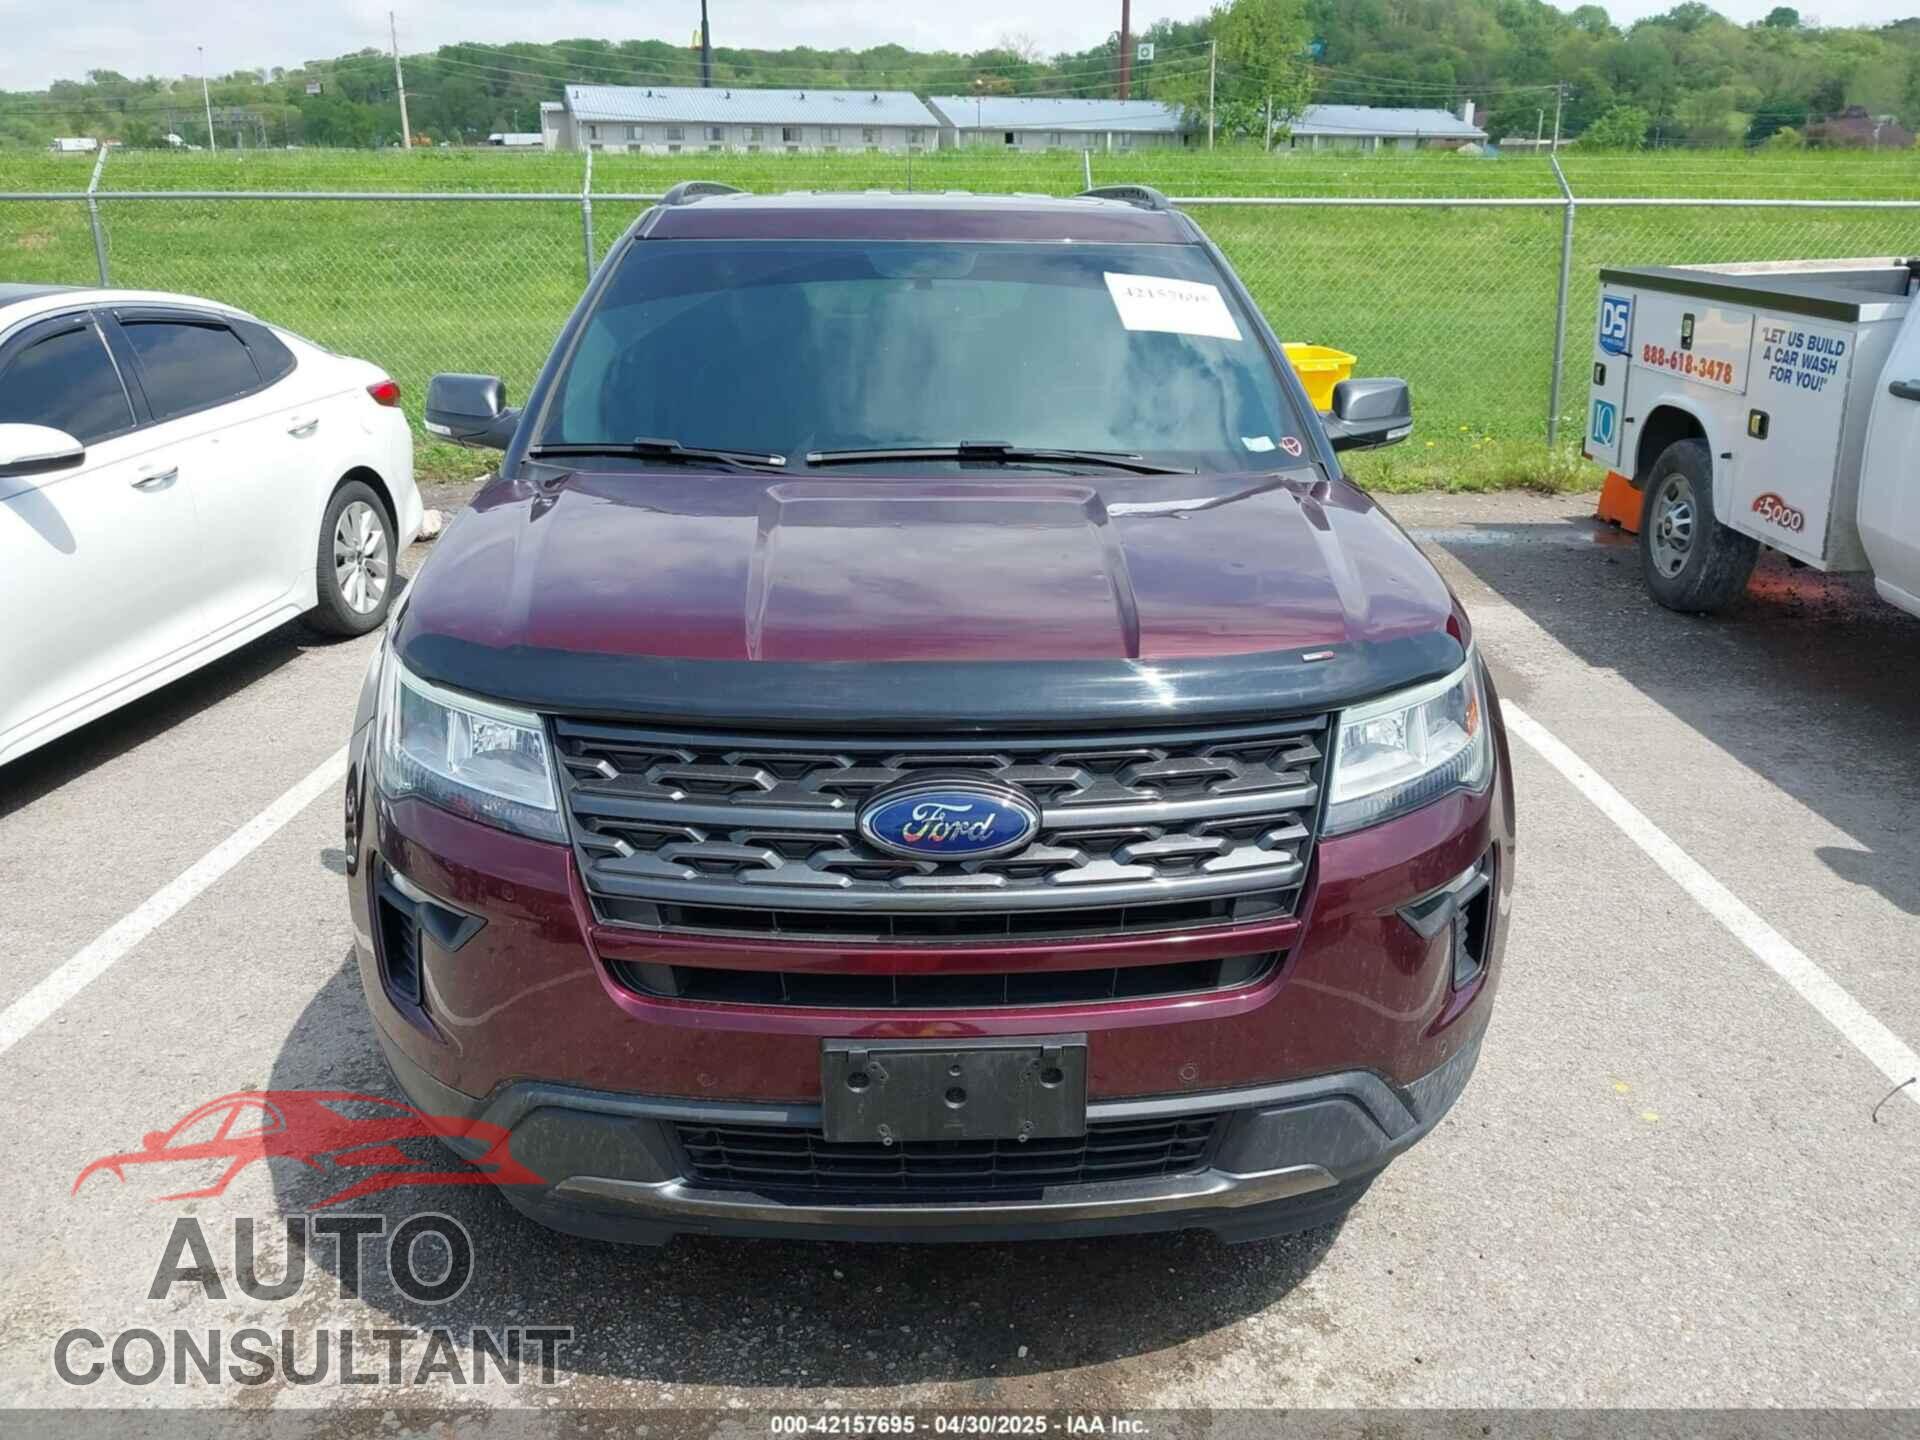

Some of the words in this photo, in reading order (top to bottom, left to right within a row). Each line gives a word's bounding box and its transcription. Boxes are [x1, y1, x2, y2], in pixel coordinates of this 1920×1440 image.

[1602, 301, 1629, 338] DS
[1762, 345, 1771, 361] A
[1774, 347, 1799, 367] CAR
[1802, 353, 1838, 376] WASH
[1787, 331, 1805, 348] US
[1807, 335, 1845, 357] BUILD
[1643, 344, 1732, 384] 888-618-3478
[1769, 365, 1793, 385] FOR
[903, 802, 996, 842] Ford
